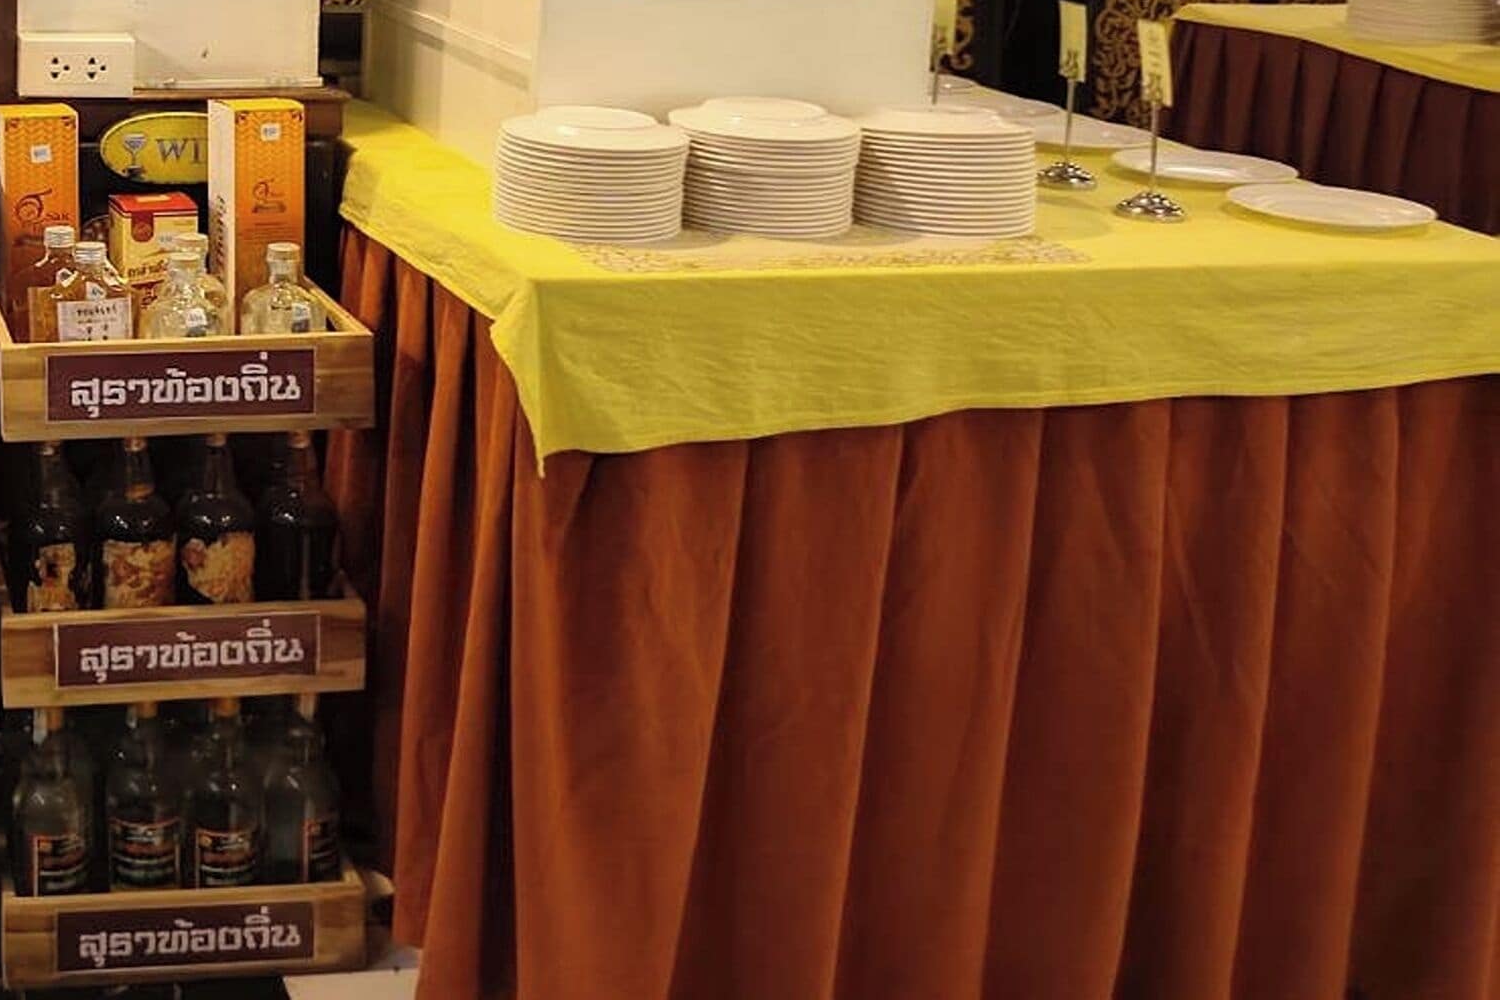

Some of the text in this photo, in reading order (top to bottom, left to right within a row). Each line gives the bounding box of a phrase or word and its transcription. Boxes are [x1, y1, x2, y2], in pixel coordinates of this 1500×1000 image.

[71, 351, 301, 418] สุราท้องถิ่น
[80, 618, 305, 684] สุราท้องถิ่น
[79, 905, 301, 969] สุราท้องถิ่น
